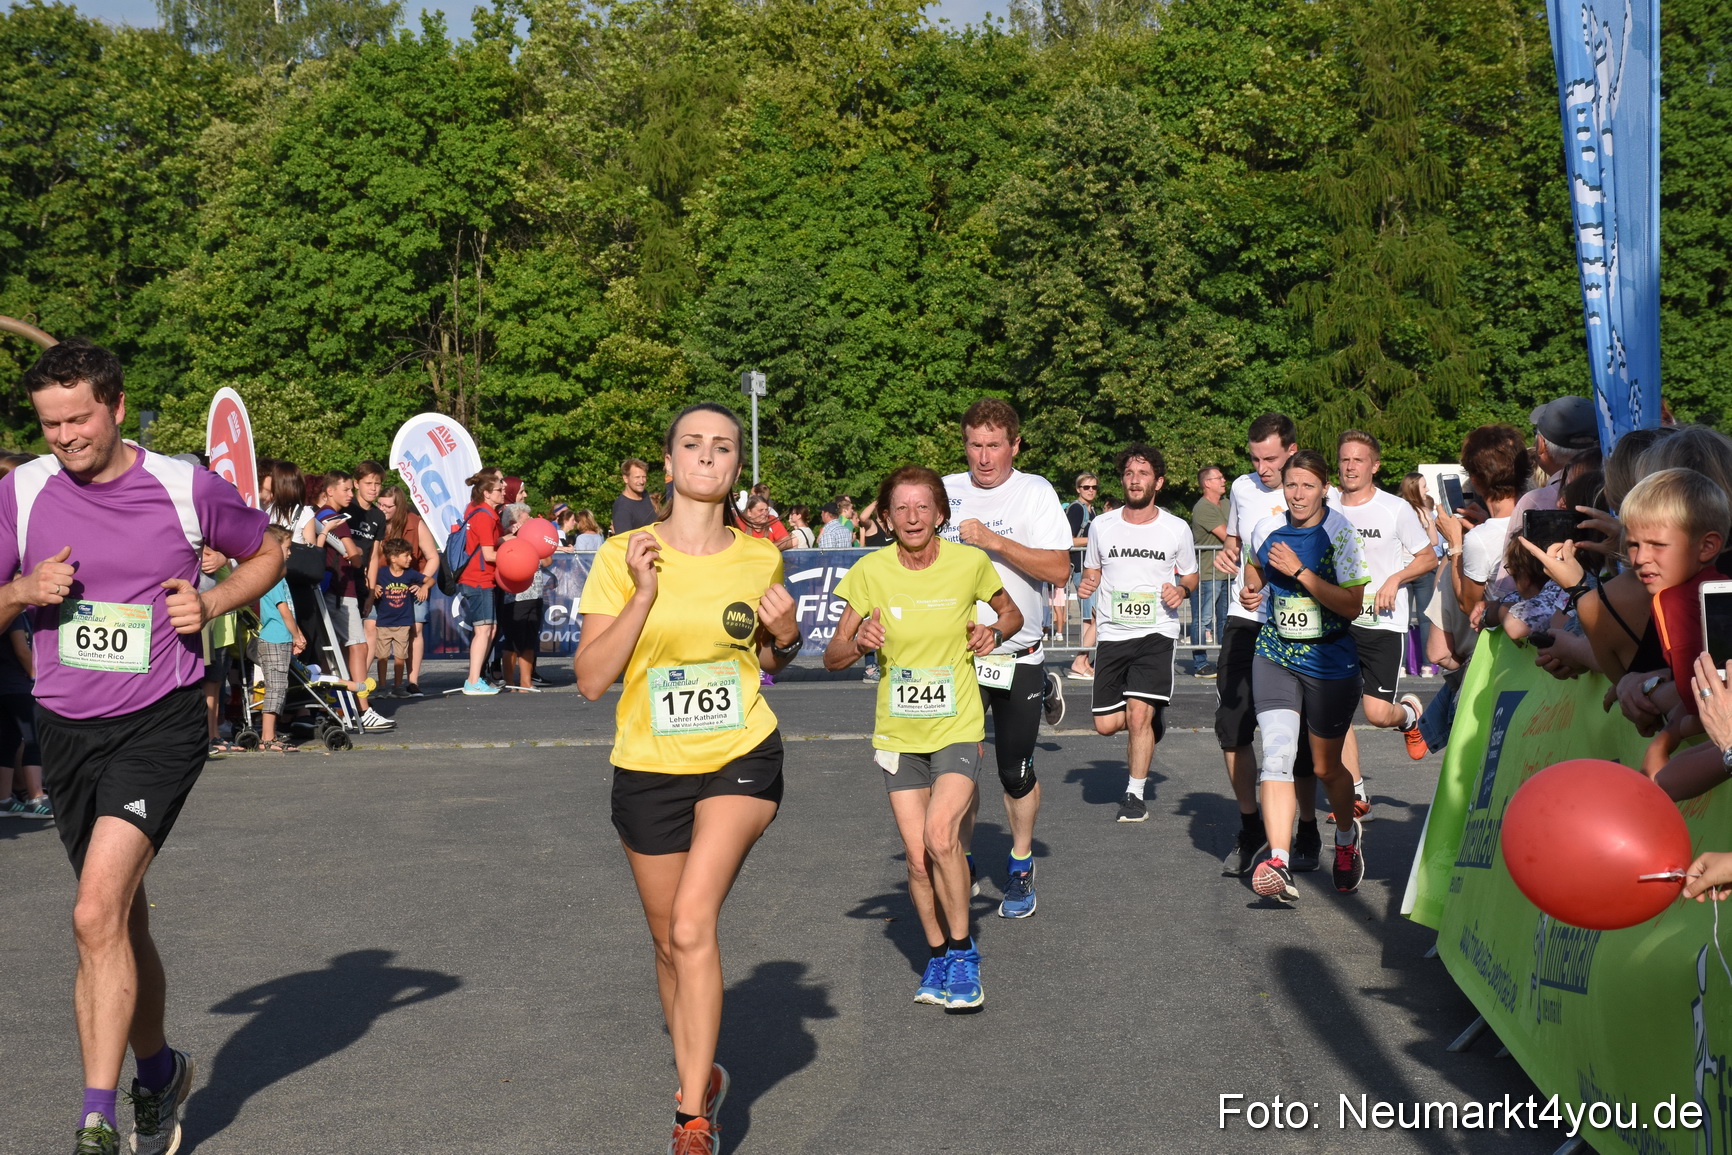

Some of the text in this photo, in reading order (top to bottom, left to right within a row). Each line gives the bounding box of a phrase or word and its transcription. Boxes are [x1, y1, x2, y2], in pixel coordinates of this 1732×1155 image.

[992, 519, 1003, 527] ist
[1120, 548, 1165, 561] MAGNA
[796, 594, 848, 622] Fis
[1117, 602, 1151, 616] 1499
[1279, 611, 1308, 627] 249
[76, 625, 128, 653] 630
[808, 627, 836, 639] AU
[77, 650, 124, 660] Günther Rico
[977, 665, 1001, 680] 130
[662, 687, 731, 716] 1763
[897, 685, 946, 704] 1244
[694, 713, 728, 721] Katharina
